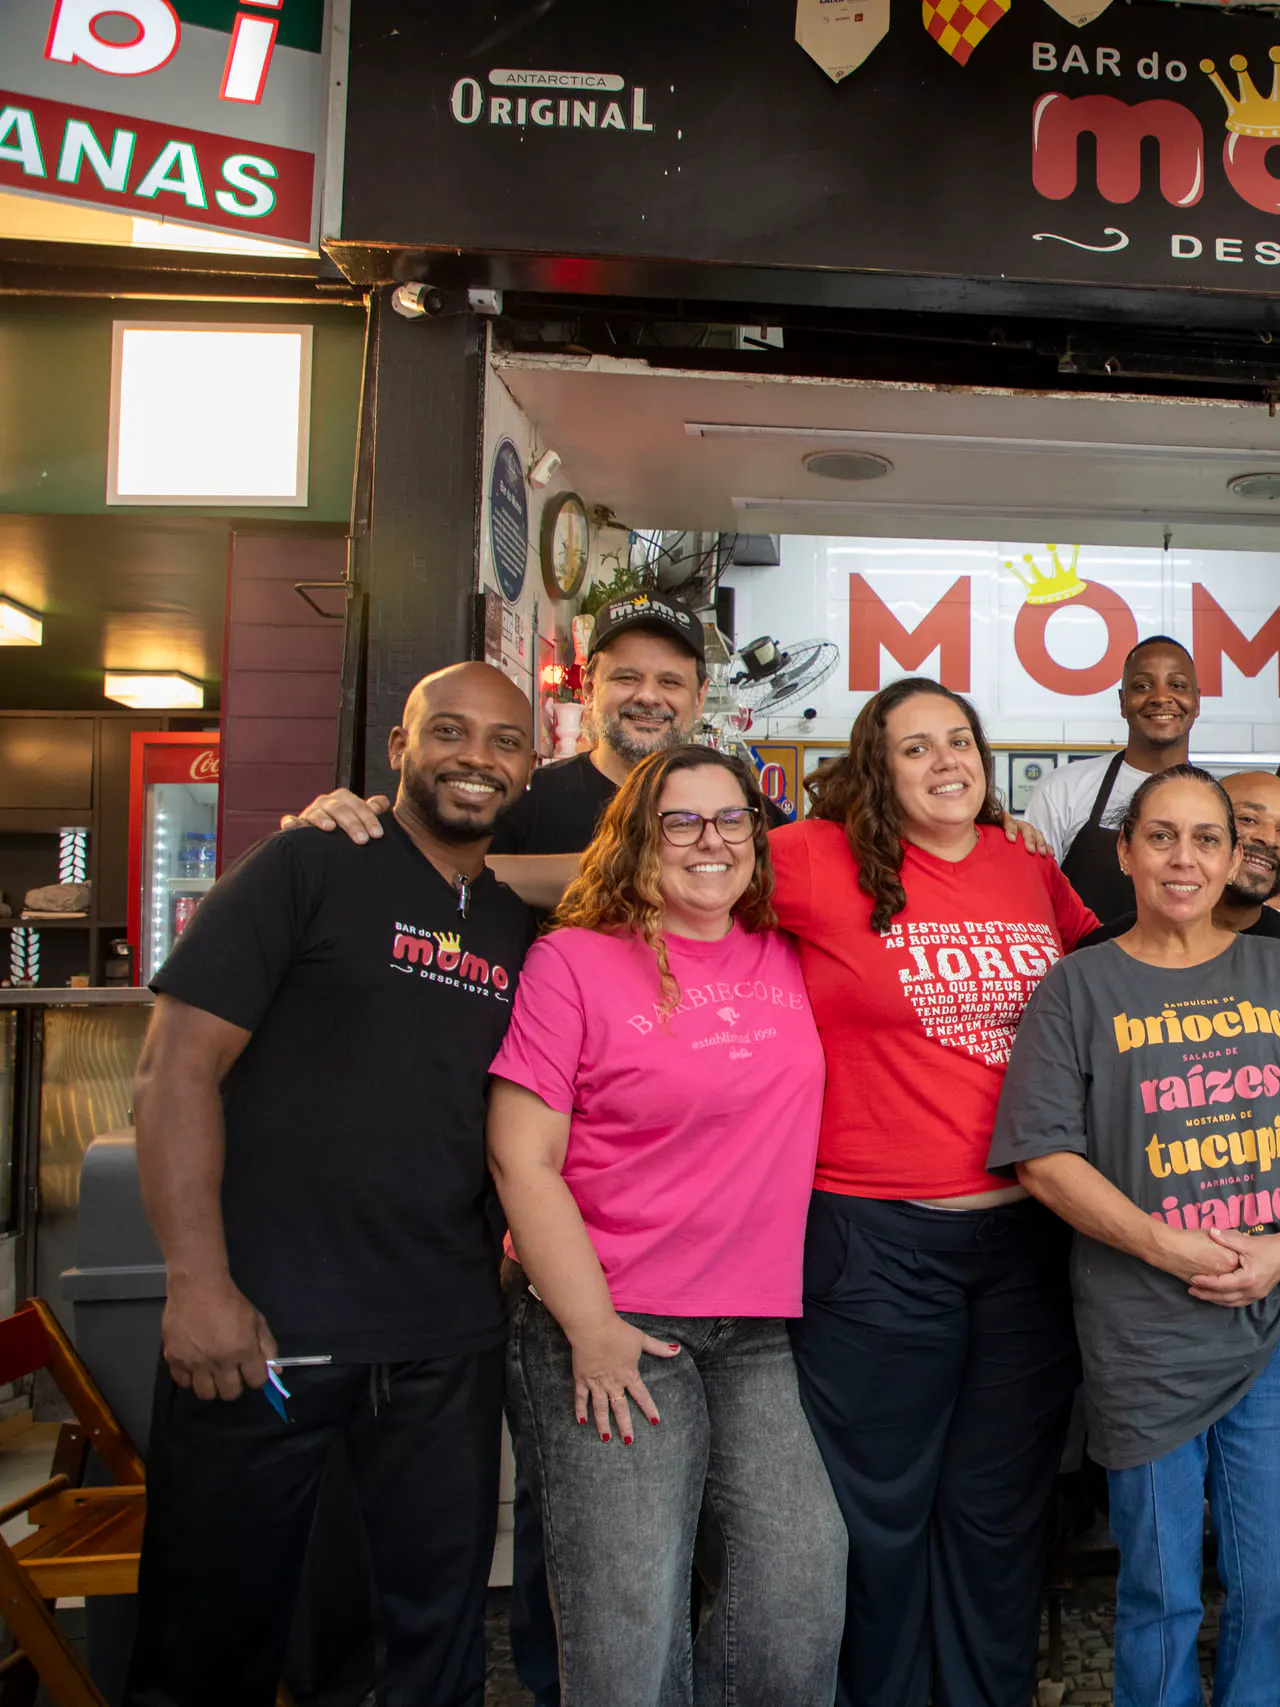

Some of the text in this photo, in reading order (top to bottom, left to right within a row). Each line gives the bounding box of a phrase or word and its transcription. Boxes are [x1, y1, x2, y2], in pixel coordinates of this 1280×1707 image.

[1032, 41, 1188, 82] BAR do
[506, 73, 607, 87] ANTARCTICA
[451, 77, 654, 133] ORIGINAL
[0, 105, 279, 218] ANAS
[610, 600, 690, 624] momo
[394, 921, 432, 938] BAR do
[907, 921, 961, 935] ESTOU
[964, 920, 1027, 934] VESTIDO
[1027, 923, 1053, 936] COM
[886, 936, 905, 949] AS
[907, 933, 968, 946] ROUPAS
[971, 935, 982, 945] E
[985, 933, 1002, 946] AS
[1005, 932, 1045, 945] ARMAS
[392, 933, 509, 990] momo
[420, 970, 490, 997] DESDE 1972
[903, 983, 944, 997] PARA
[949, 981, 978, 993] QUE
[982, 980, 1022, 992] MEUS
[911, 994, 954, 1007] TENDO
[981, 991, 1005, 1003] NÃO
[1008, 992, 1025, 1002] ME
[916, 1005, 957, 1017] TENDO
[920, 1015, 958, 1027] TENDO
[926, 1027, 934, 1038] E
[936, 1023, 964, 1036] NEM
[965, 1019, 982, 1033] EM
[940, 1033, 978, 1047] ELES
[981, 1025, 1018, 1041] POSSA
[966, 1038, 1009, 1056] FAZER
[1182, 1047, 1239, 1062] SALADA DE
[1186, 1110, 1253, 1127] MOSTARDA DE
[1200, 1174, 1256, 1190] BARRIGA DE
